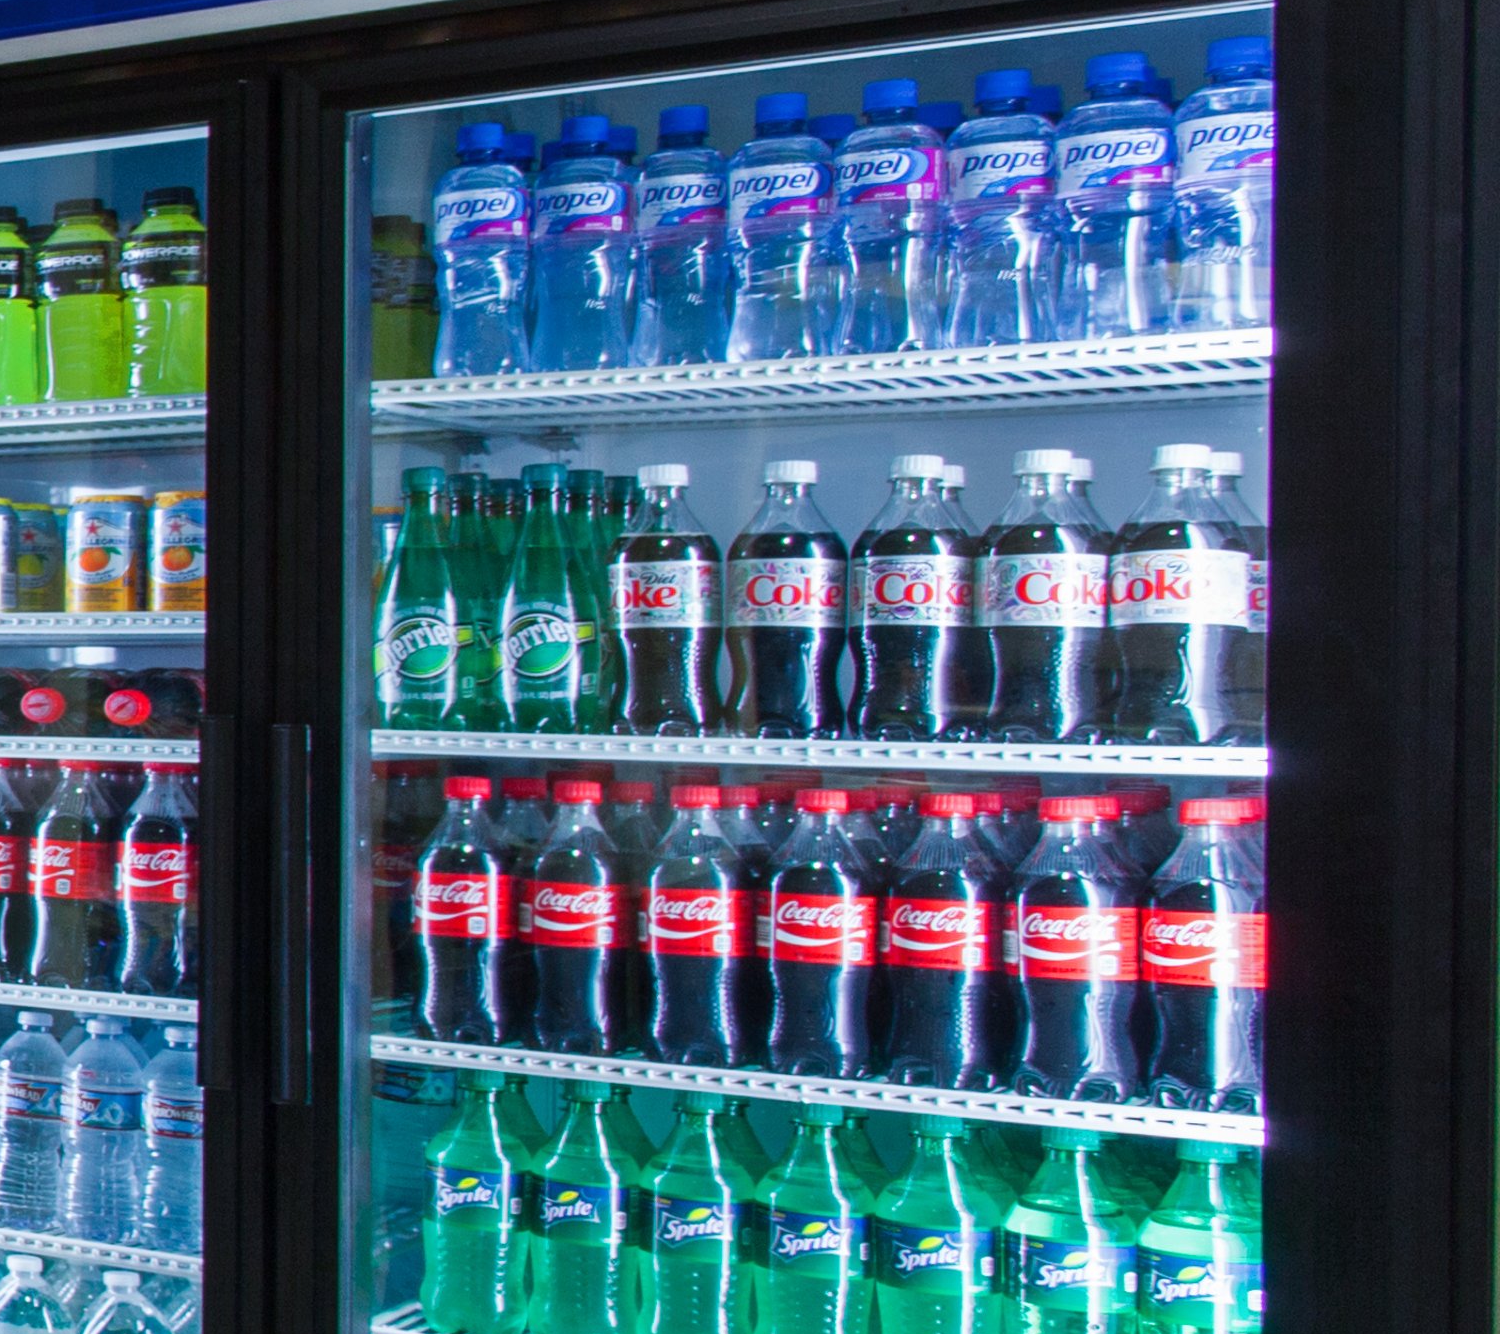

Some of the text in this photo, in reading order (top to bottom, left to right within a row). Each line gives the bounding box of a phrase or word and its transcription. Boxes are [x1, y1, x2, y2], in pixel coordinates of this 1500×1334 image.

[1063, 133, 1160, 172] propel
[642, 177, 723, 209] propel
[730, 168, 816, 206] propel
[436, 192, 519, 221] propel
[536, 187, 610, 216] propel
[122, 245, 201, 263] POWERADE
[641, 571, 677, 587] Diet
[745, 573, 841, 608] Coke
[873, 572, 973, 607] Coke
[534, 887, 613, 915] Coca-Cola
[649, 894, 733, 922] Coca-Cola
[776, 899, 864, 927] Coca-Cola
[891, 904, 980, 933] Coca-Cola
[1021, 911, 1116, 941] Coca-Cola
[437, 1184, 495, 1211] Sprite
[541, 1196, 594, 1222] Sprite
[664, 1214, 725, 1241] Sprite
[780, 1229, 841, 1257] Sprite
[899, 1244, 961, 1272] Sprite
